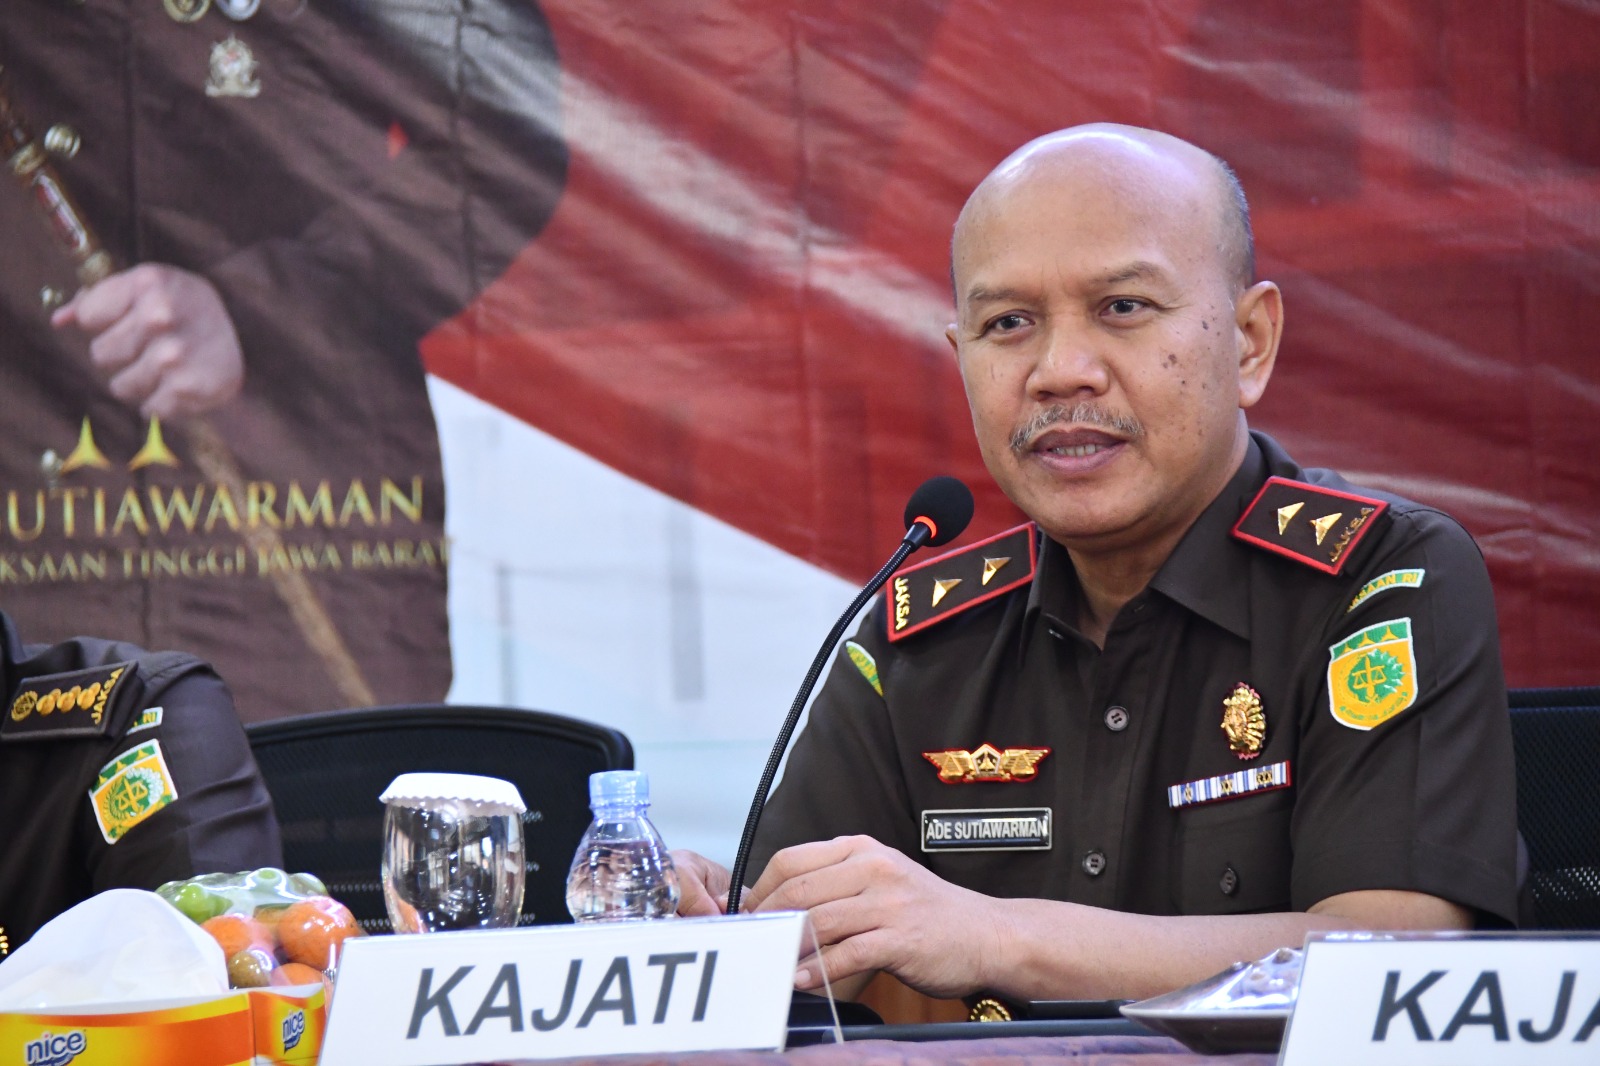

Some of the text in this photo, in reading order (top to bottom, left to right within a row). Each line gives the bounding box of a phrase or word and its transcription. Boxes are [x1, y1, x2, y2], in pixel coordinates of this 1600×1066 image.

[122, 545, 246, 580] TINGGI
[257, 540, 342, 578] JAWA
[1402, 573, 1419, 584] RI
[894, 577, 911, 631] JAKSA
[91, 667, 125, 725] JAKSA
[926, 819, 1049, 840] ADE SUTIAWARMAN
[405, 949, 719, 1041] KAJATI
[282, 1009, 304, 1041] nice
[27, 1032, 83, 1062] nice
